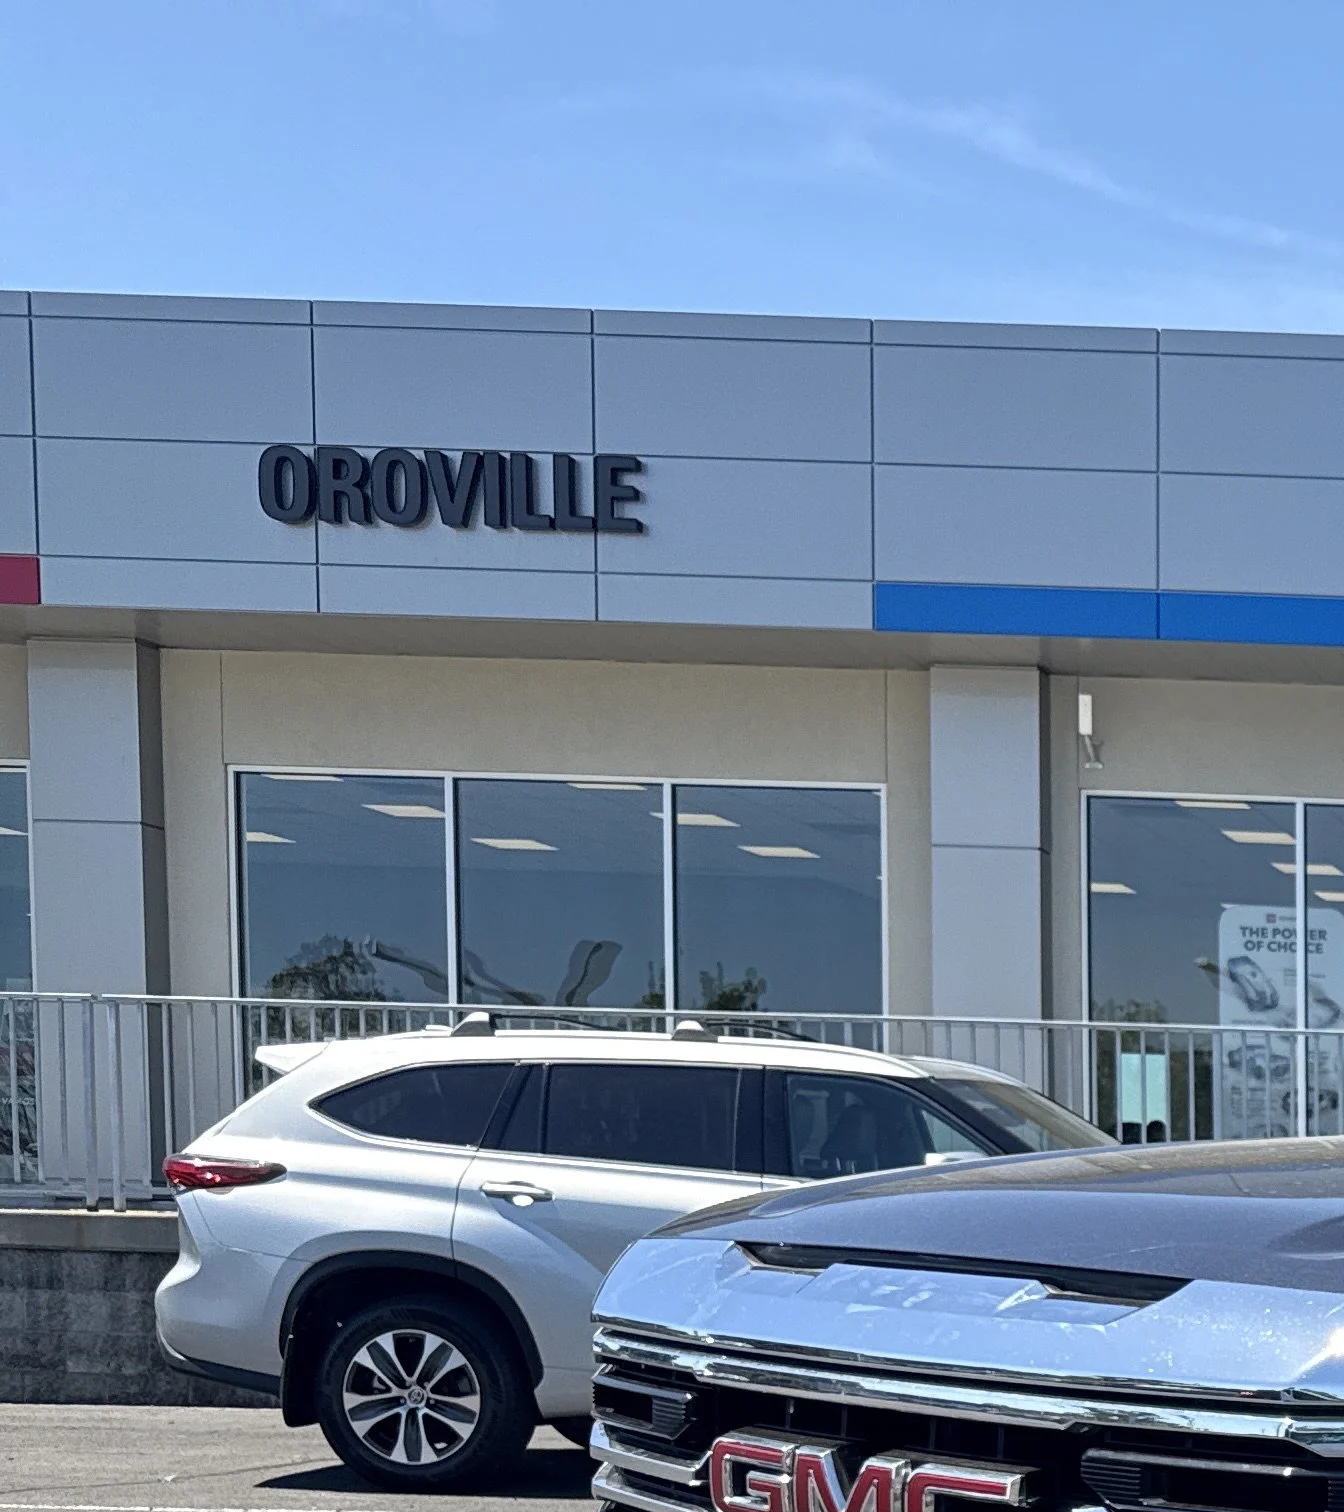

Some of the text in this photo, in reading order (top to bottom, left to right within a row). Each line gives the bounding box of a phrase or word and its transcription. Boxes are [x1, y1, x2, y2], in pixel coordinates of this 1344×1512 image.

[258, 445, 644, 533] OROVILLE
[1240, 926, 1327, 941] THE POER
[1244, 940, 1324, 954] OF CHOCE
